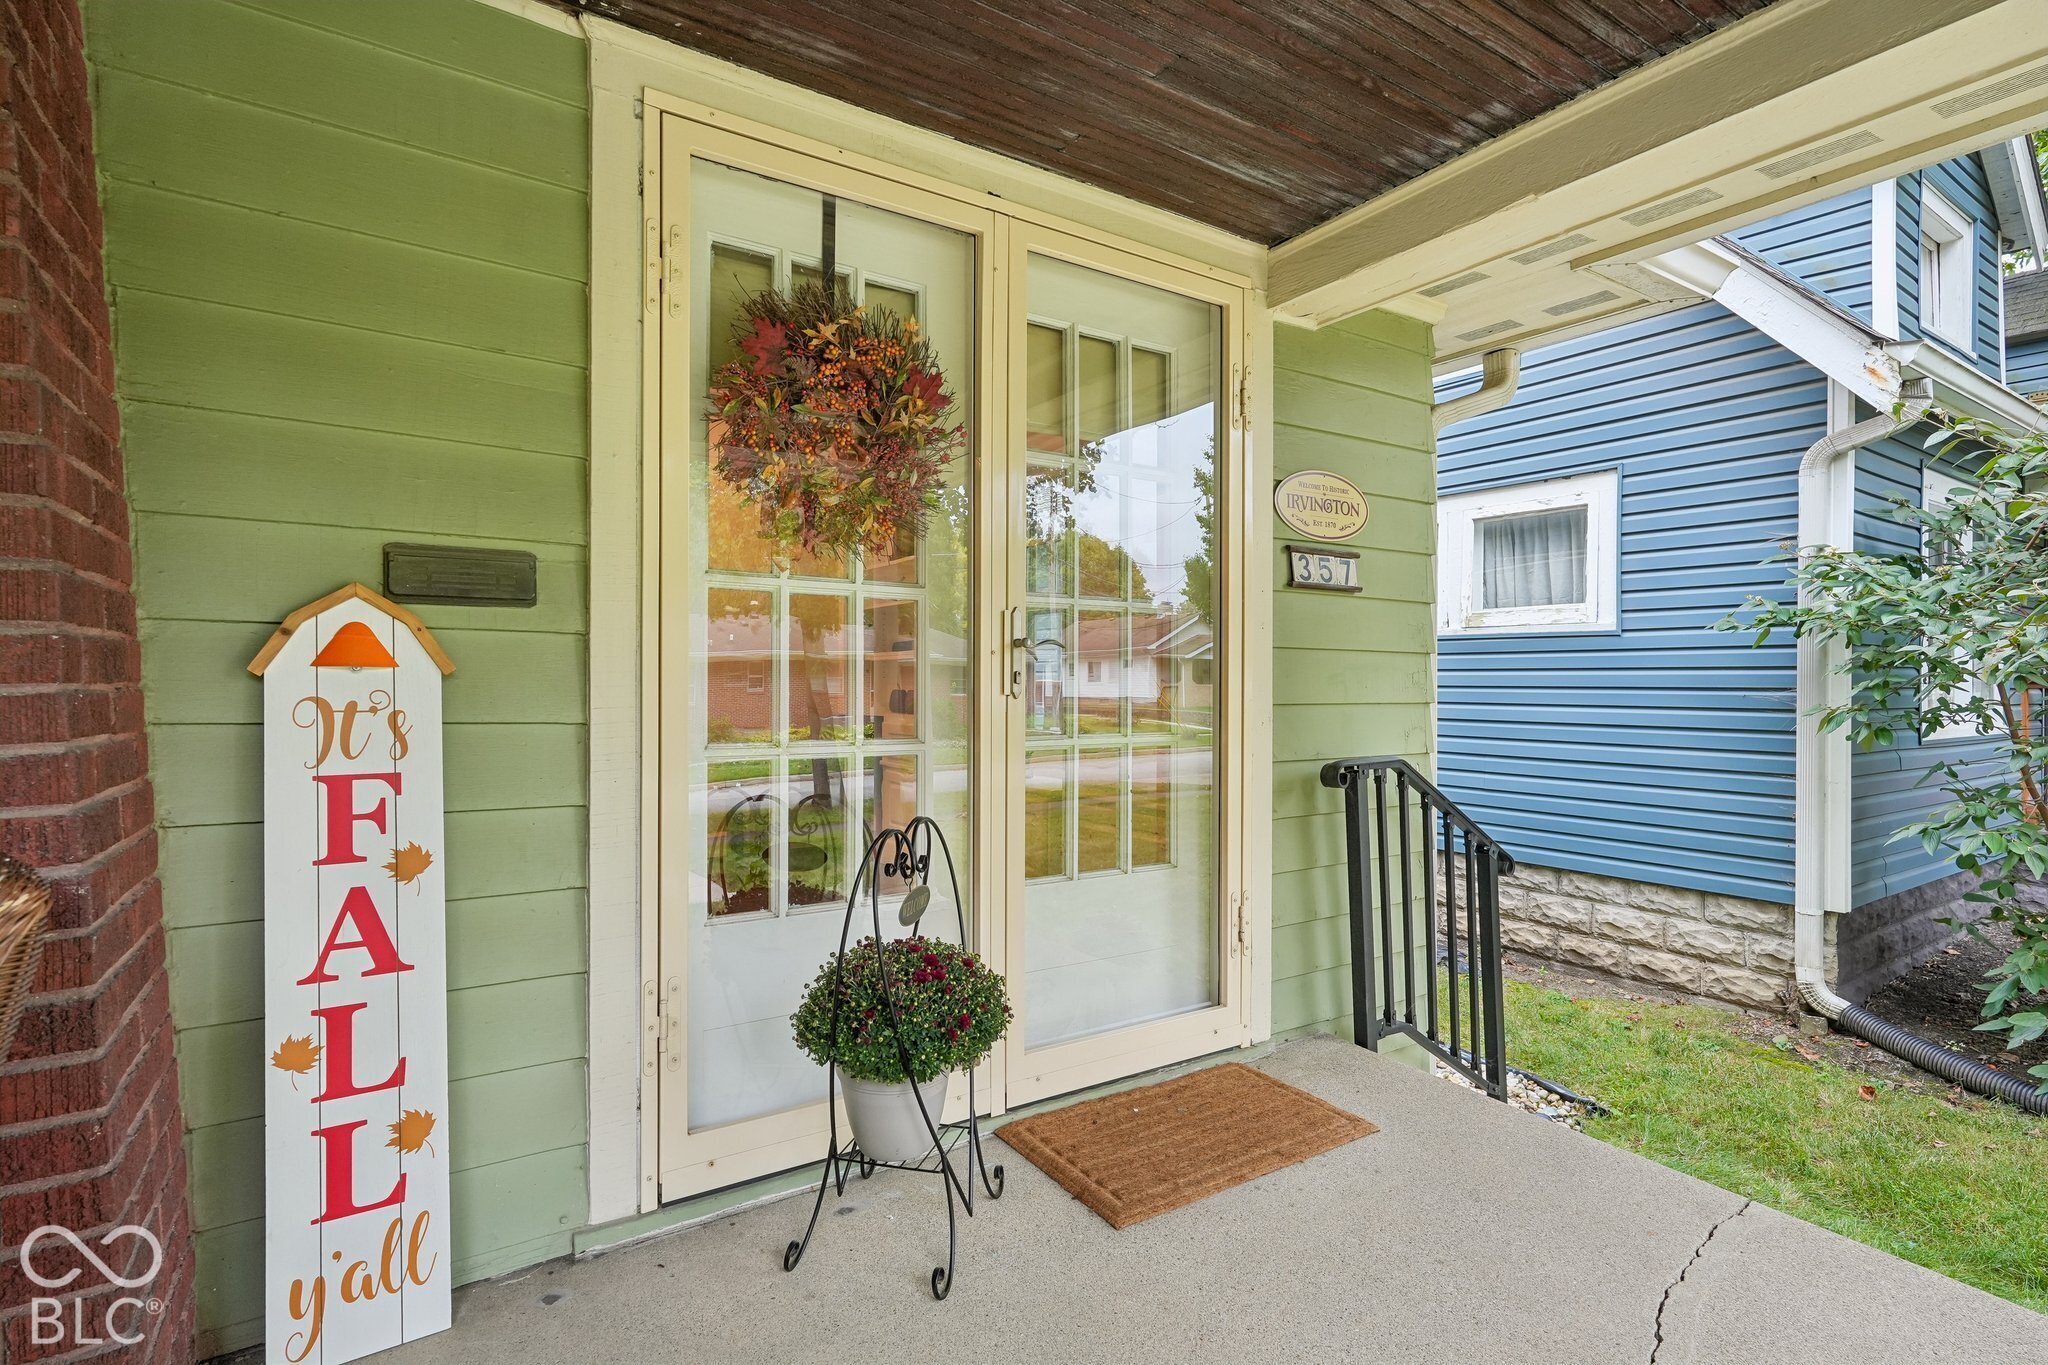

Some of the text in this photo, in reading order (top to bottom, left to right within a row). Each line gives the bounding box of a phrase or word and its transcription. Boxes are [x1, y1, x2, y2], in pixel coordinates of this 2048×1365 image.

[1286, 493, 1360, 518] IRVINGTON
[1298, 554, 1351, 585] 357
[292, 689, 414, 769] It's
[296, 772, 415, 1226] FALL
[285, 1210, 438, 1363] y'all
